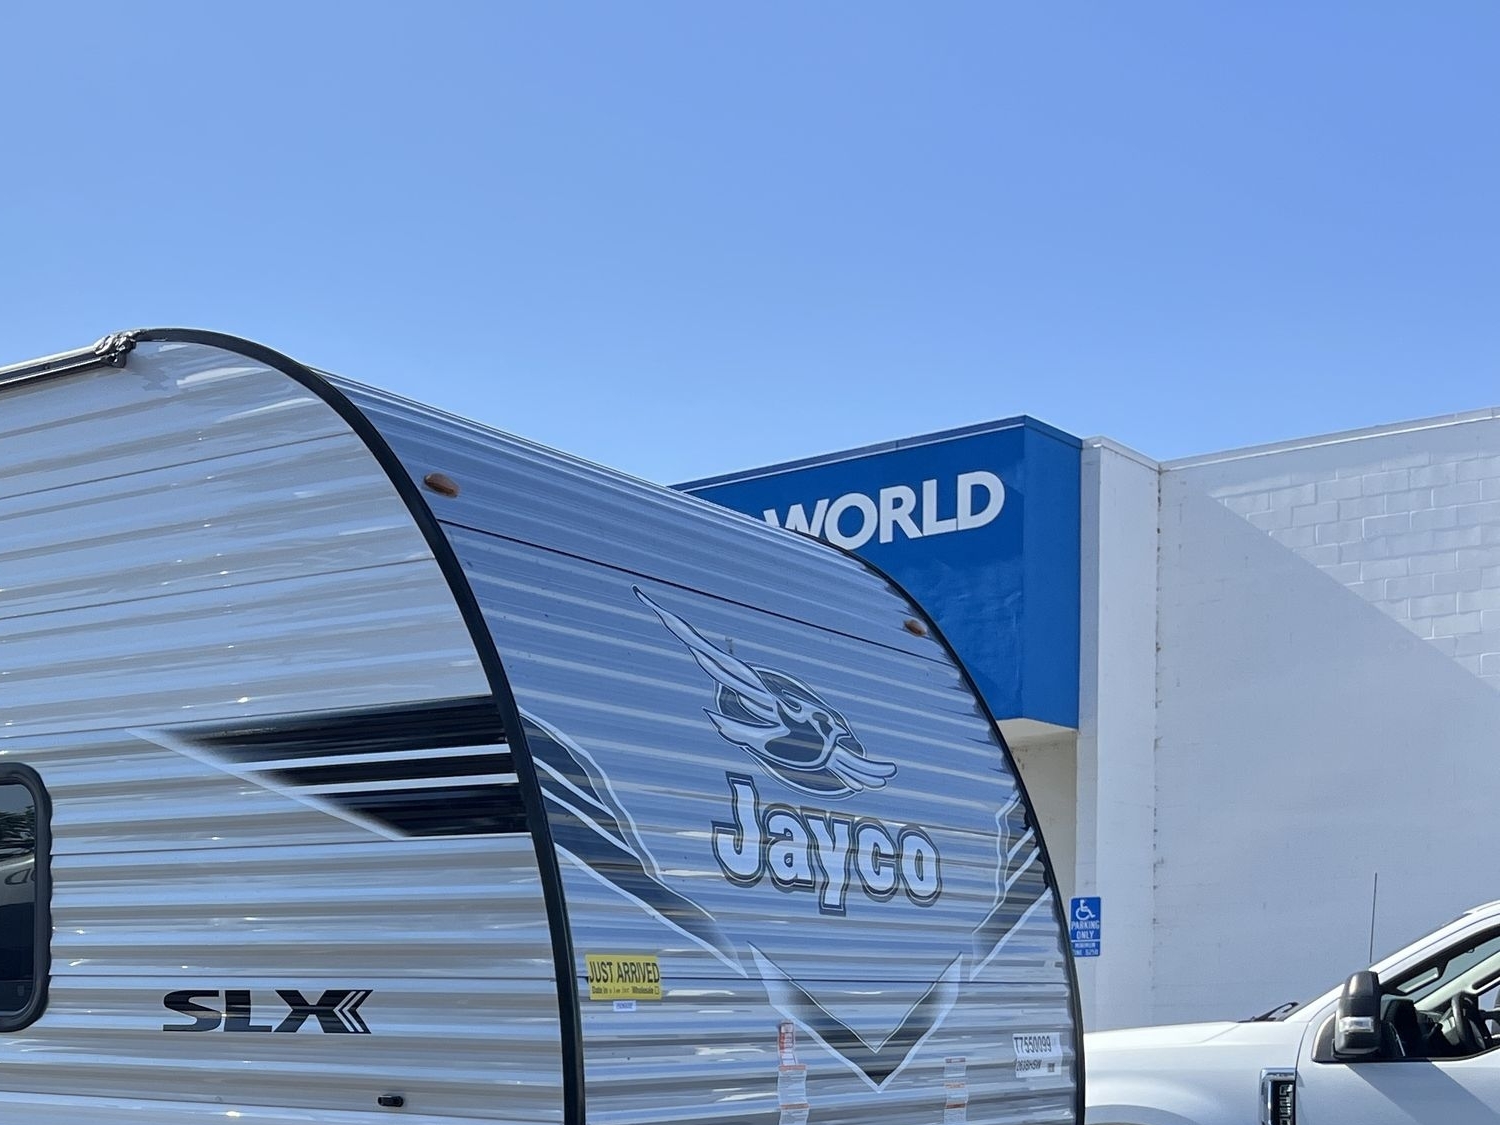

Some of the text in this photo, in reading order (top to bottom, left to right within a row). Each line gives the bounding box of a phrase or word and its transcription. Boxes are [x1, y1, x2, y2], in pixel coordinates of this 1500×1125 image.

[763, 470, 1006, 551] WORLD
[711, 771, 943, 917] Jayco
[1071, 920, 1100, 930] PARKING
[1076, 930, 1095, 940] ONLY
[589, 961, 661, 984] JUST ARRIVED
[162, 989, 373, 1035] SLX
